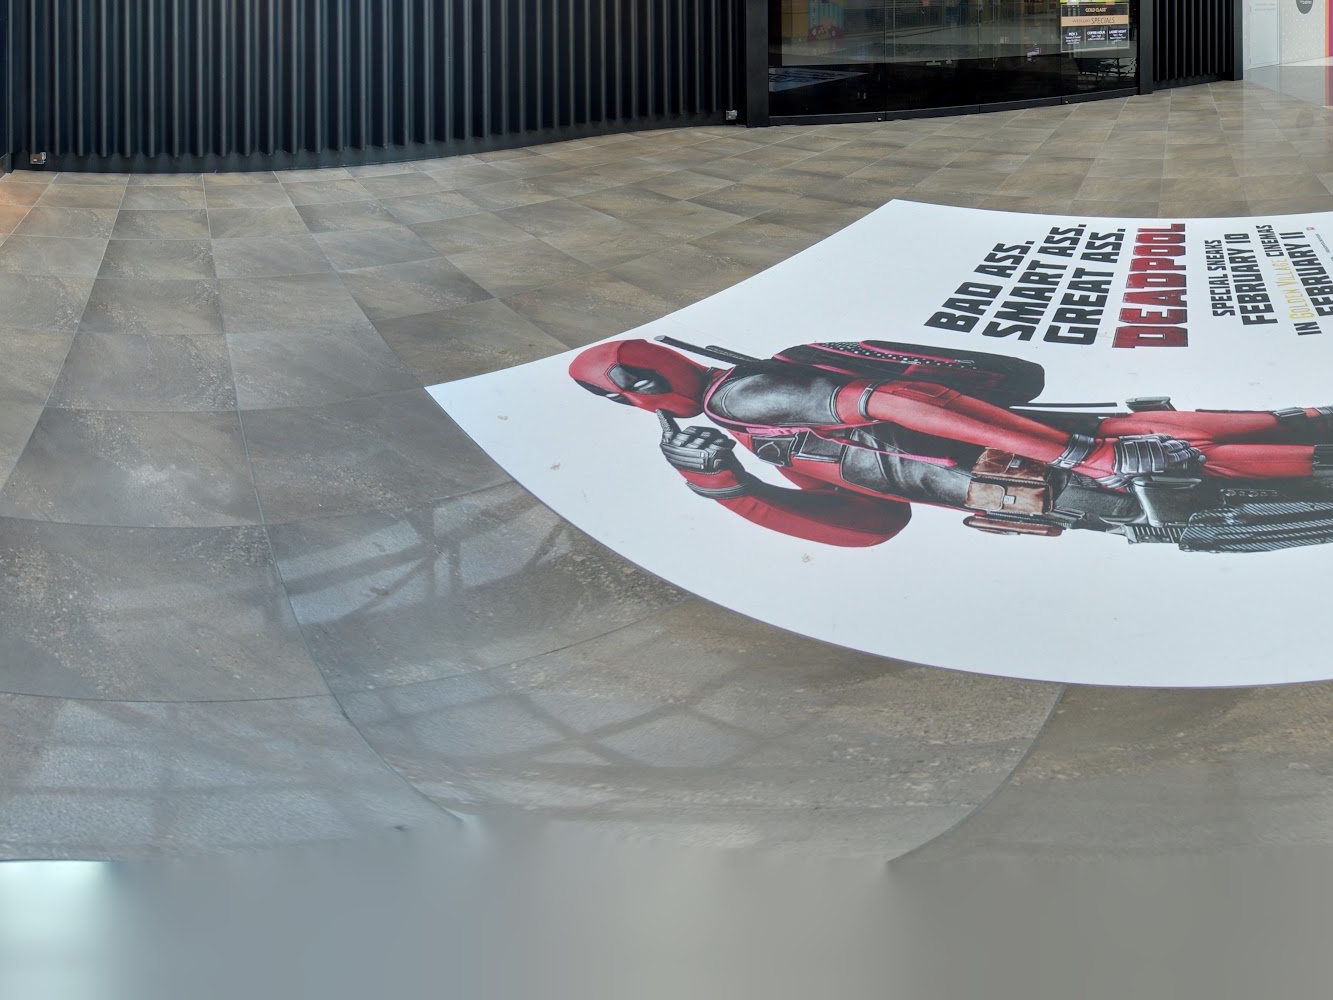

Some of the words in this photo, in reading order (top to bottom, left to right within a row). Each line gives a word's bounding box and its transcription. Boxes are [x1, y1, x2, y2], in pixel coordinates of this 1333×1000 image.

[1224, 233, 1251, 244] 10
[1256, 224, 1284, 258] CINEMAS
[1279, 231, 1306, 240] 11
[1204, 239, 1227, 271] SNEAKS
[923, 281, 1003, 333] BAD
[973, 241, 1035, 278] ASS.
[982, 260, 1068, 341] SMART
[1037, 224, 1087, 257] ASS.
[1043, 267, 1115, 345] GREAT
[1080, 228, 1126, 263] ASS.
[1112, 223, 1188, 348] DEADPOOL
[1227, 248, 1278, 325] FEBRUARY
[1271, 259, 1298, 287] VILLAGE
[1208, 274, 1236, 316] SPECIAL
[1283, 288, 1316, 319] GOLDEN
[1294, 321, 1322, 336] IN
